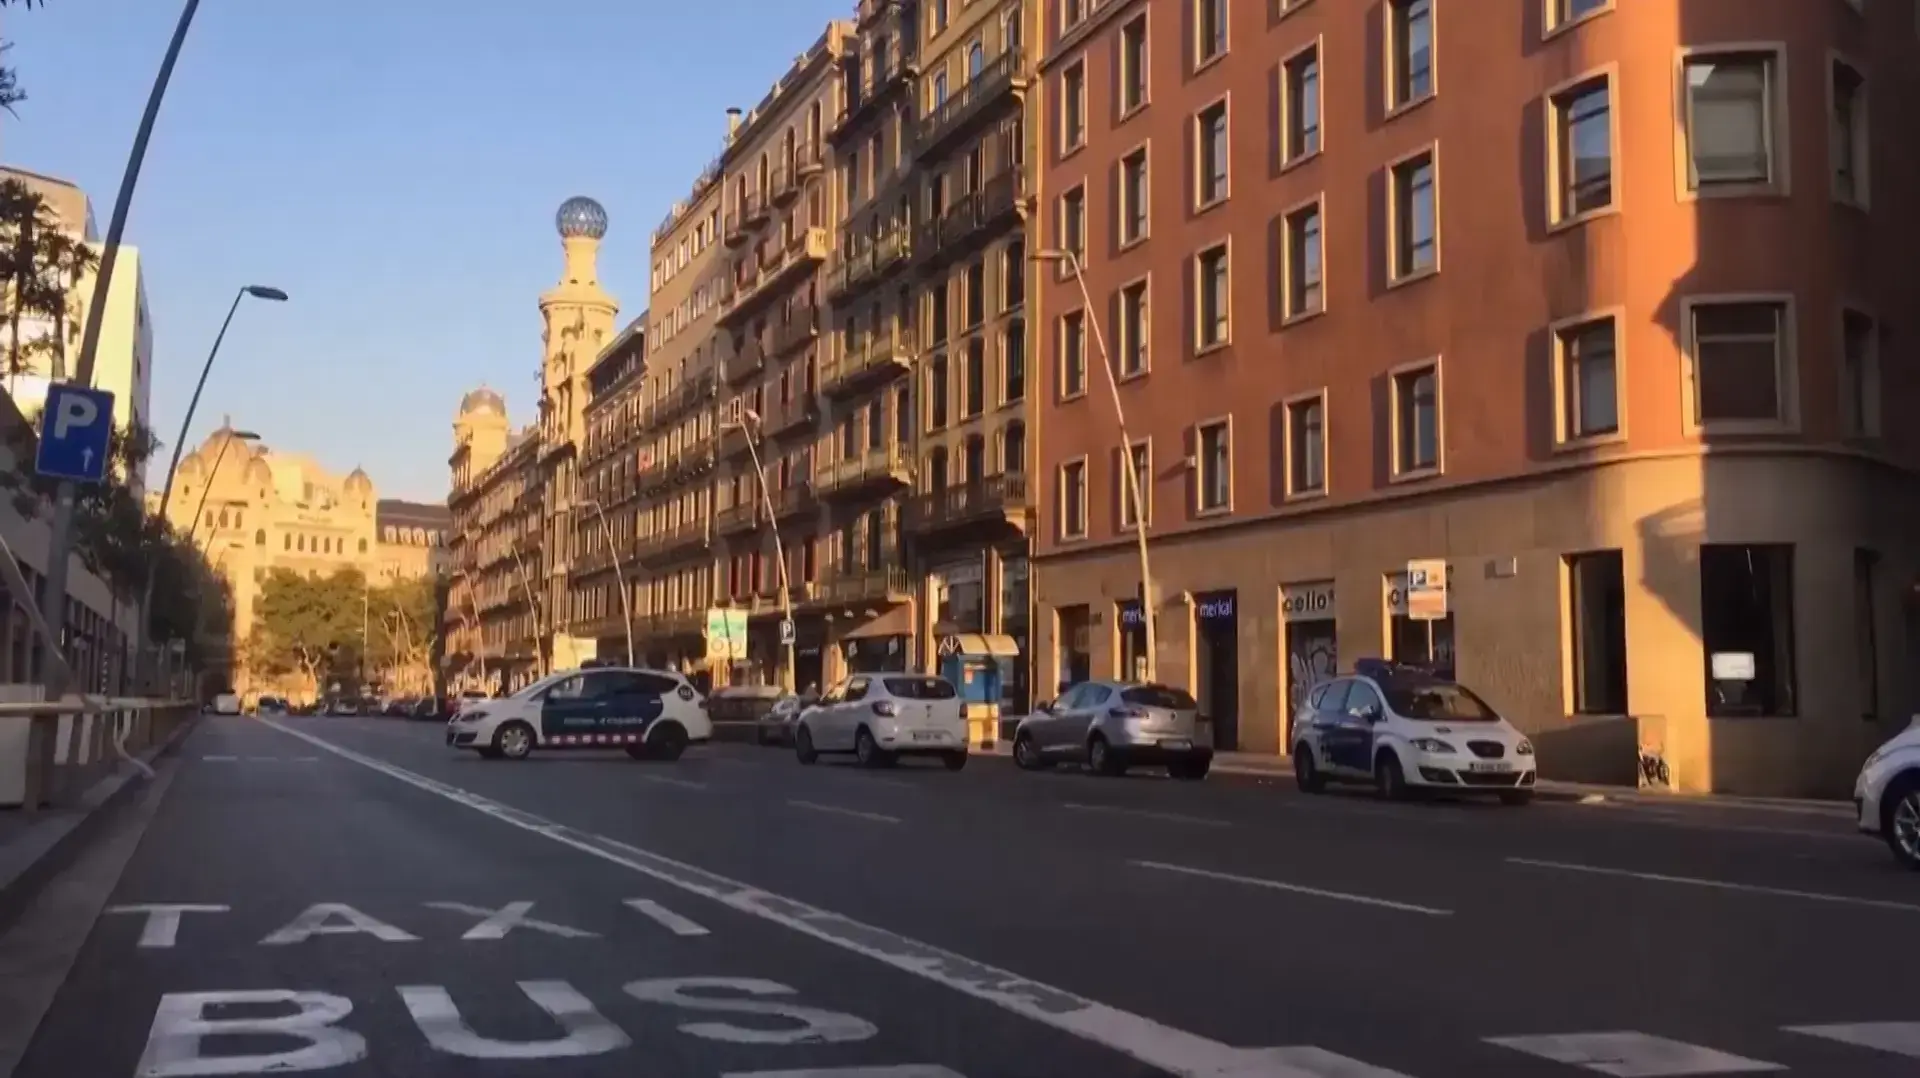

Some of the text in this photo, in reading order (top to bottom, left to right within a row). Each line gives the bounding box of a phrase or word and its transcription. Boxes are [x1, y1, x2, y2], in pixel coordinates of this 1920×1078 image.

[55, 392, 97, 440] P
[1200, 598, 1233, 617] merkal
[104, 898, 711, 949] TAXI
[133, 976, 880, 1078] BUS
